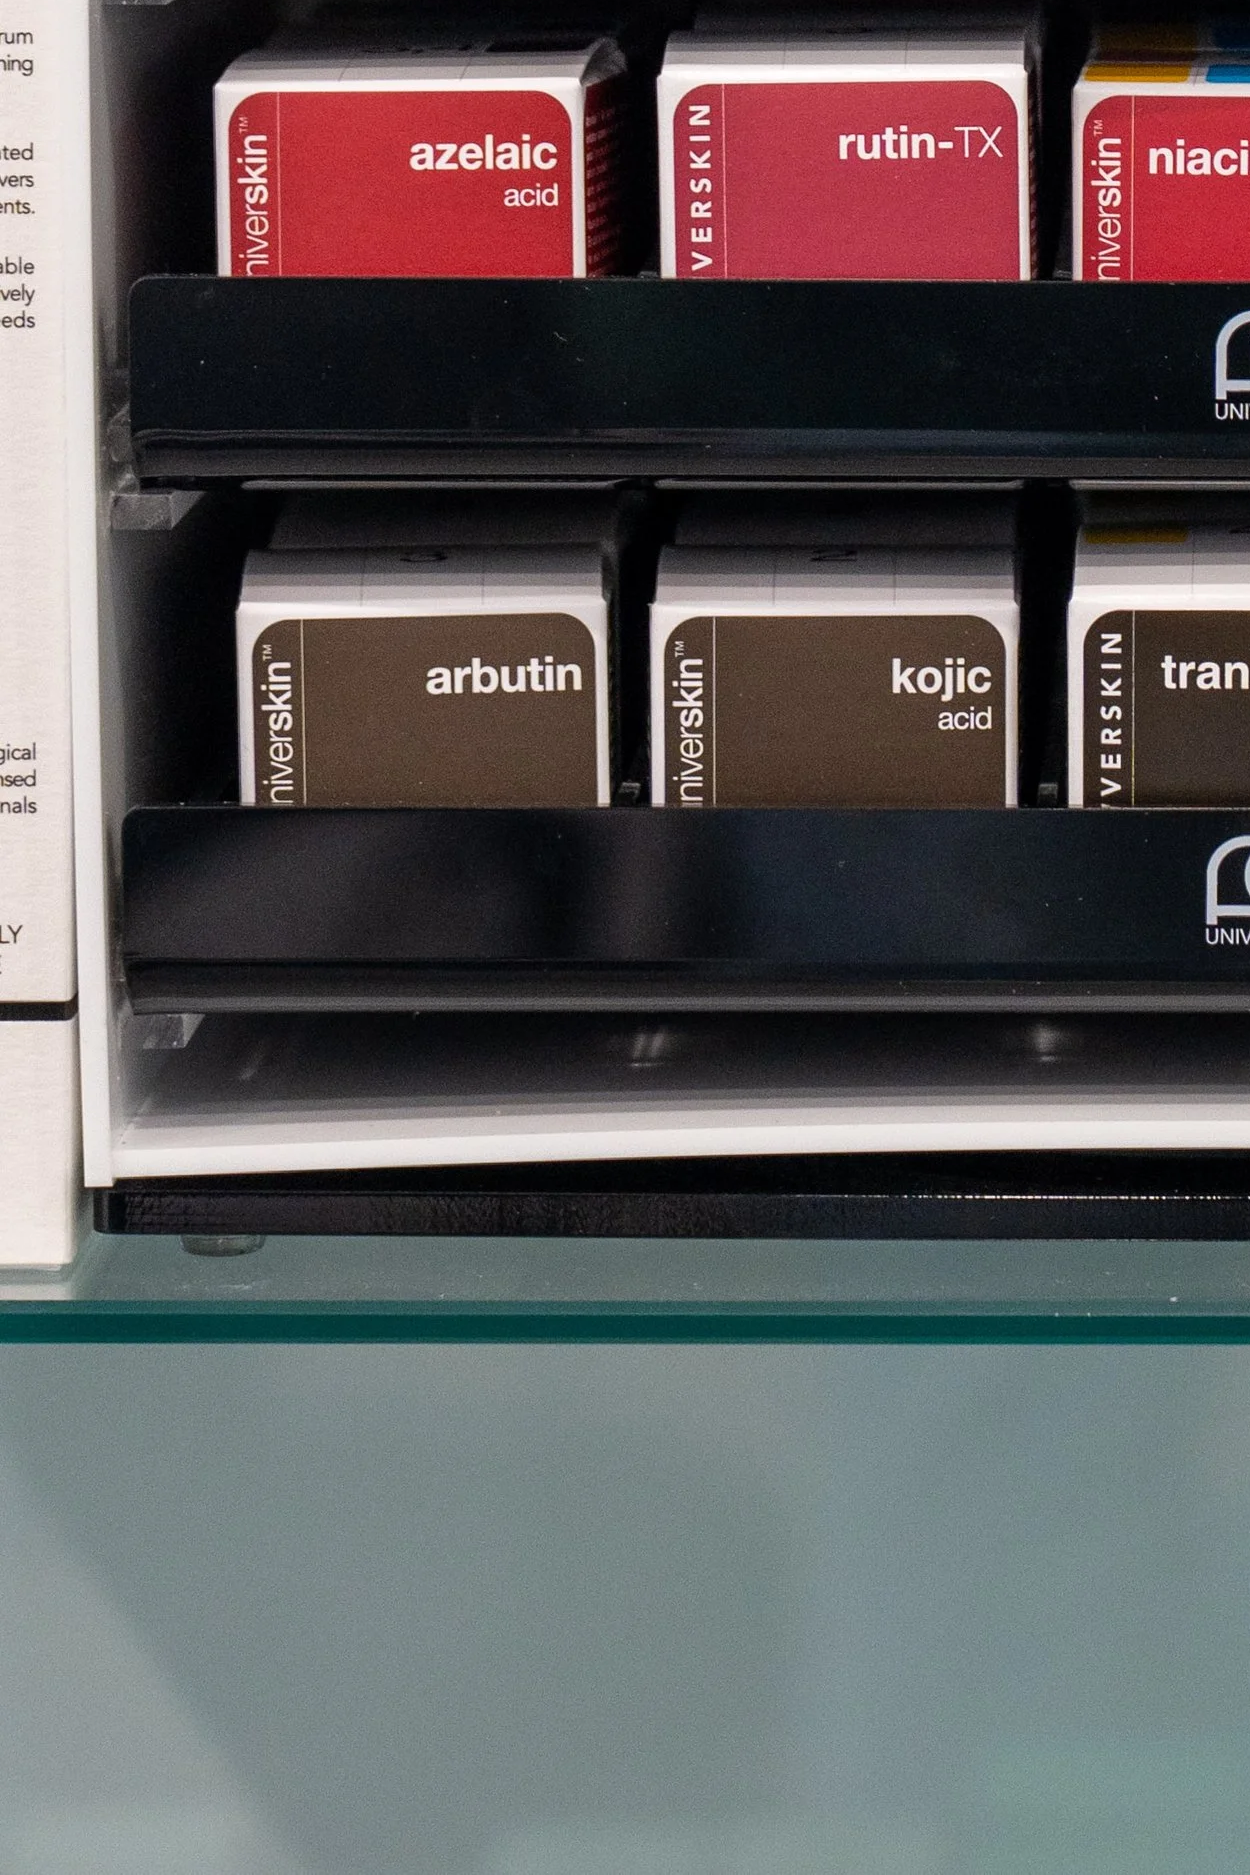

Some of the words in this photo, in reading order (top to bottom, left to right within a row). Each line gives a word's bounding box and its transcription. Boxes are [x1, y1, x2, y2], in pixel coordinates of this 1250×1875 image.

[409, 134, 558, 171] azelaic
[839, 125, 1003, 160] rutin-TX
[504, 183, 558, 207] acid
[688, 105, 713, 271] VERSKIN
[426, 656, 582, 695] arbutin
[892, 657, 991, 702] kojic
[938, 706, 992, 730] acid
[1100, 633, 1123, 796] VERSKIN
